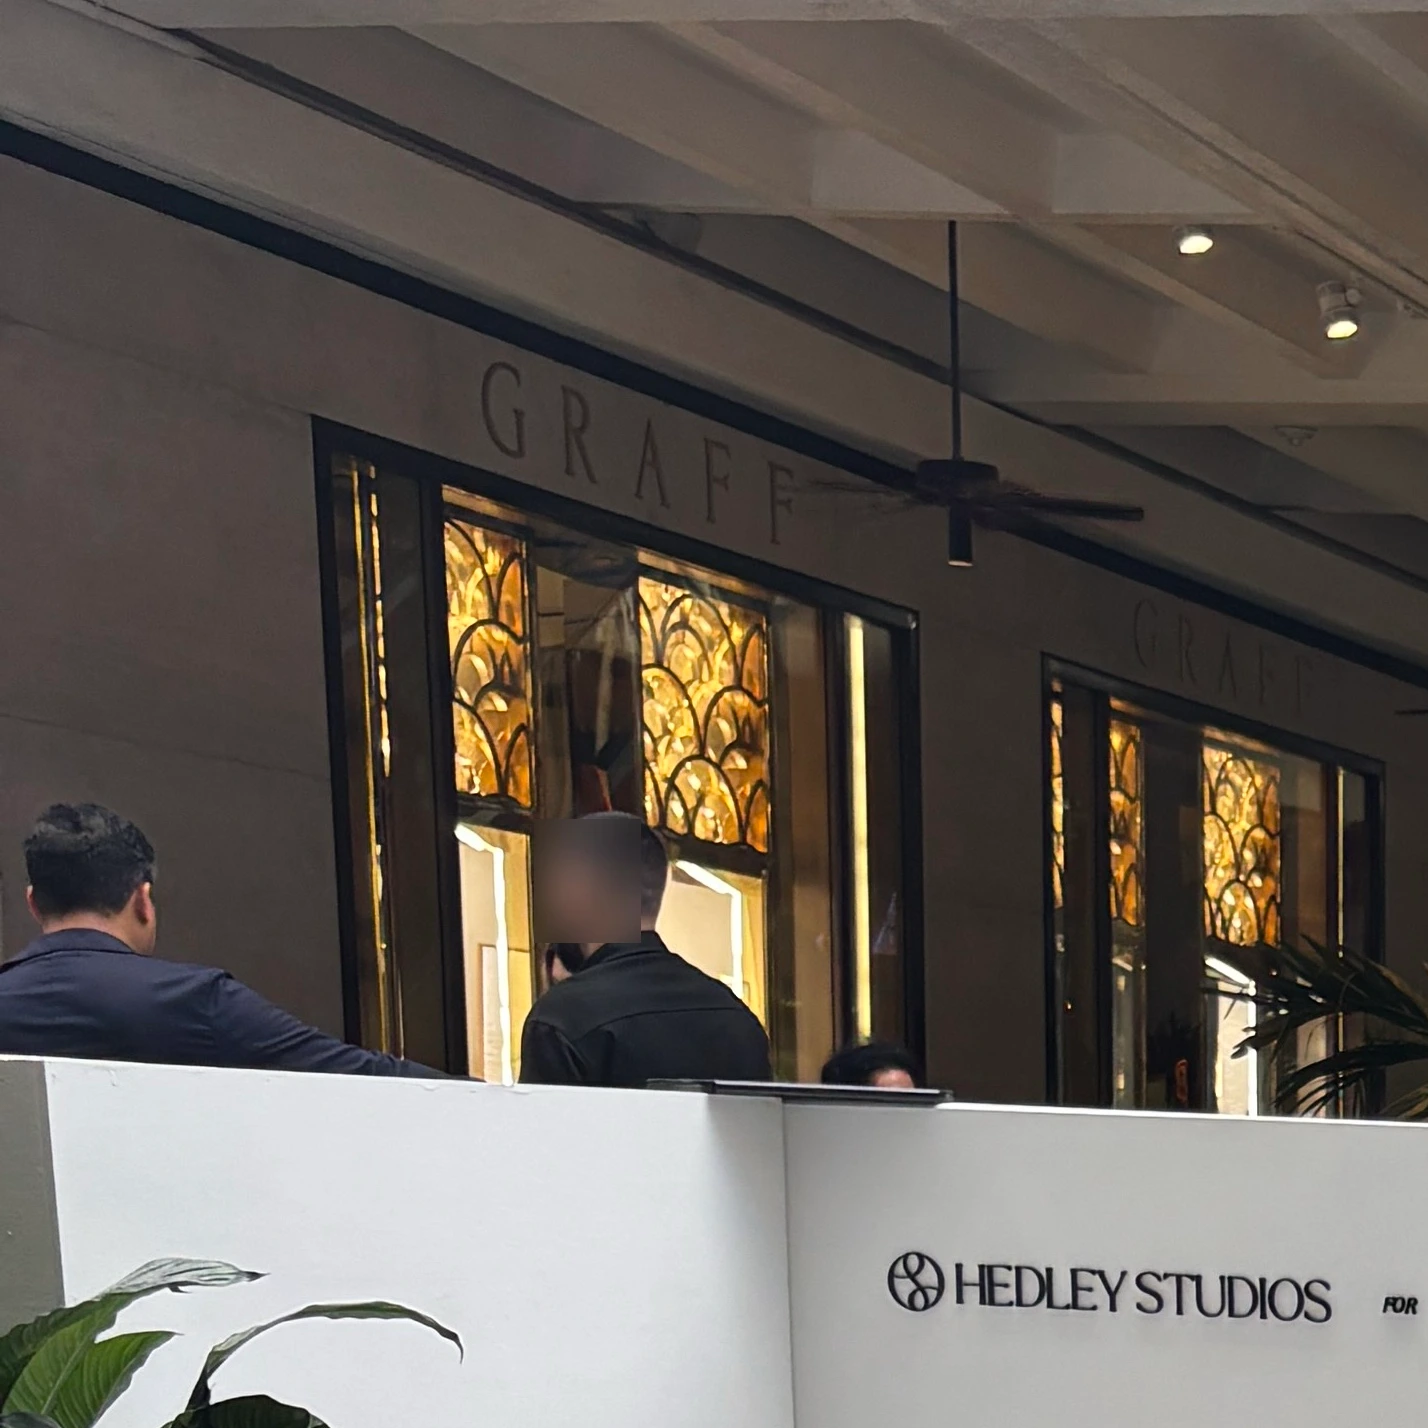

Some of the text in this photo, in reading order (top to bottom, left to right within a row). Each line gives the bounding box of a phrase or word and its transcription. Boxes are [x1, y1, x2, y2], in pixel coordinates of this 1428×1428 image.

[480, 360, 798, 546] GRAFF
[1133, 598, 1314, 716] GRAFF
[954, 1263, 1128, 1313] HEDLEY
[1134, 1271, 1333, 1323] STUDIOS
[1382, 1296, 1418, 1315] FOR
